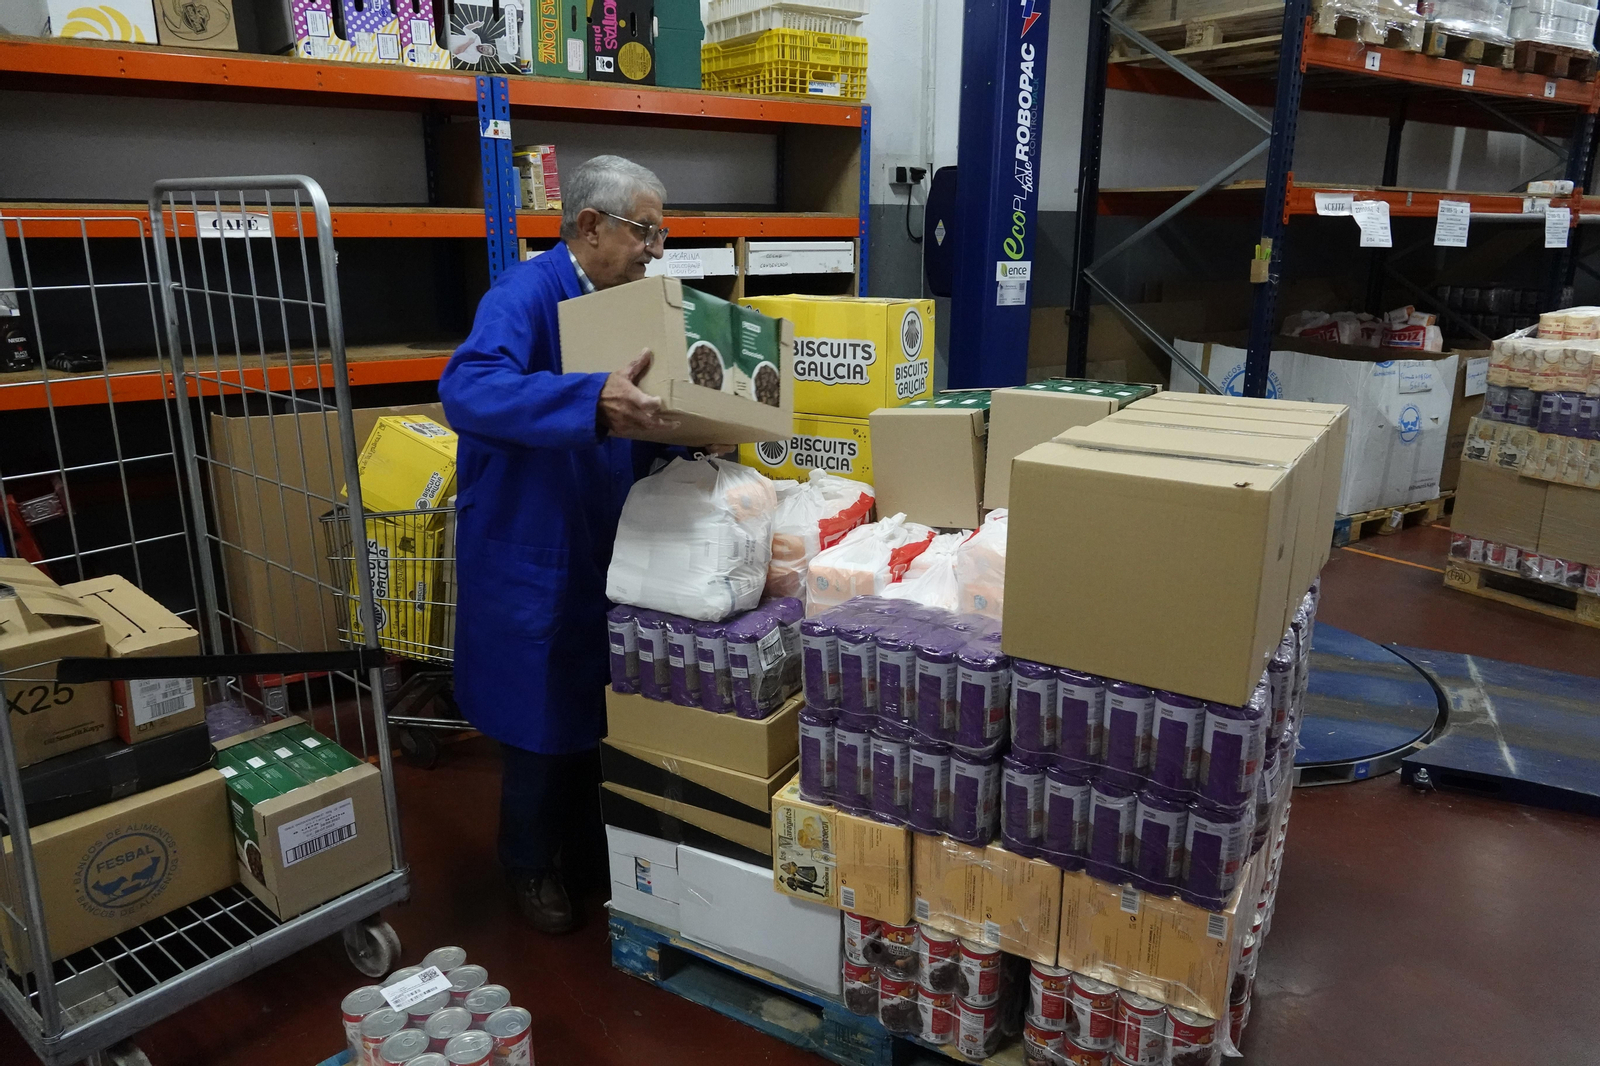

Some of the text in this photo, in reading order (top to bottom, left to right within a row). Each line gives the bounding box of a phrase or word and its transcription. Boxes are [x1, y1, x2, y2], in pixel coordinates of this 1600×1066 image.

[593, 25, 602, 53] plus
[1370, 56, 1376, 67] 1
[1465, 73, 1471, 83] 2
[1015, 42, 1035, 162] ROBOPAC
[1008, 266, 1028, 276] ence
[793, 340, 873, 361] BISCUITS
[895, 361, 928, 380] BISCUITS
[790, 437, 857, 457] BISCUITS
[422, 471, 439, 498] BISCUITS
[106, 828, 122, 840] DE
[126, 823, 176, 849] ALIMENTOS
[96, 845, 155, 874] FESBAL
